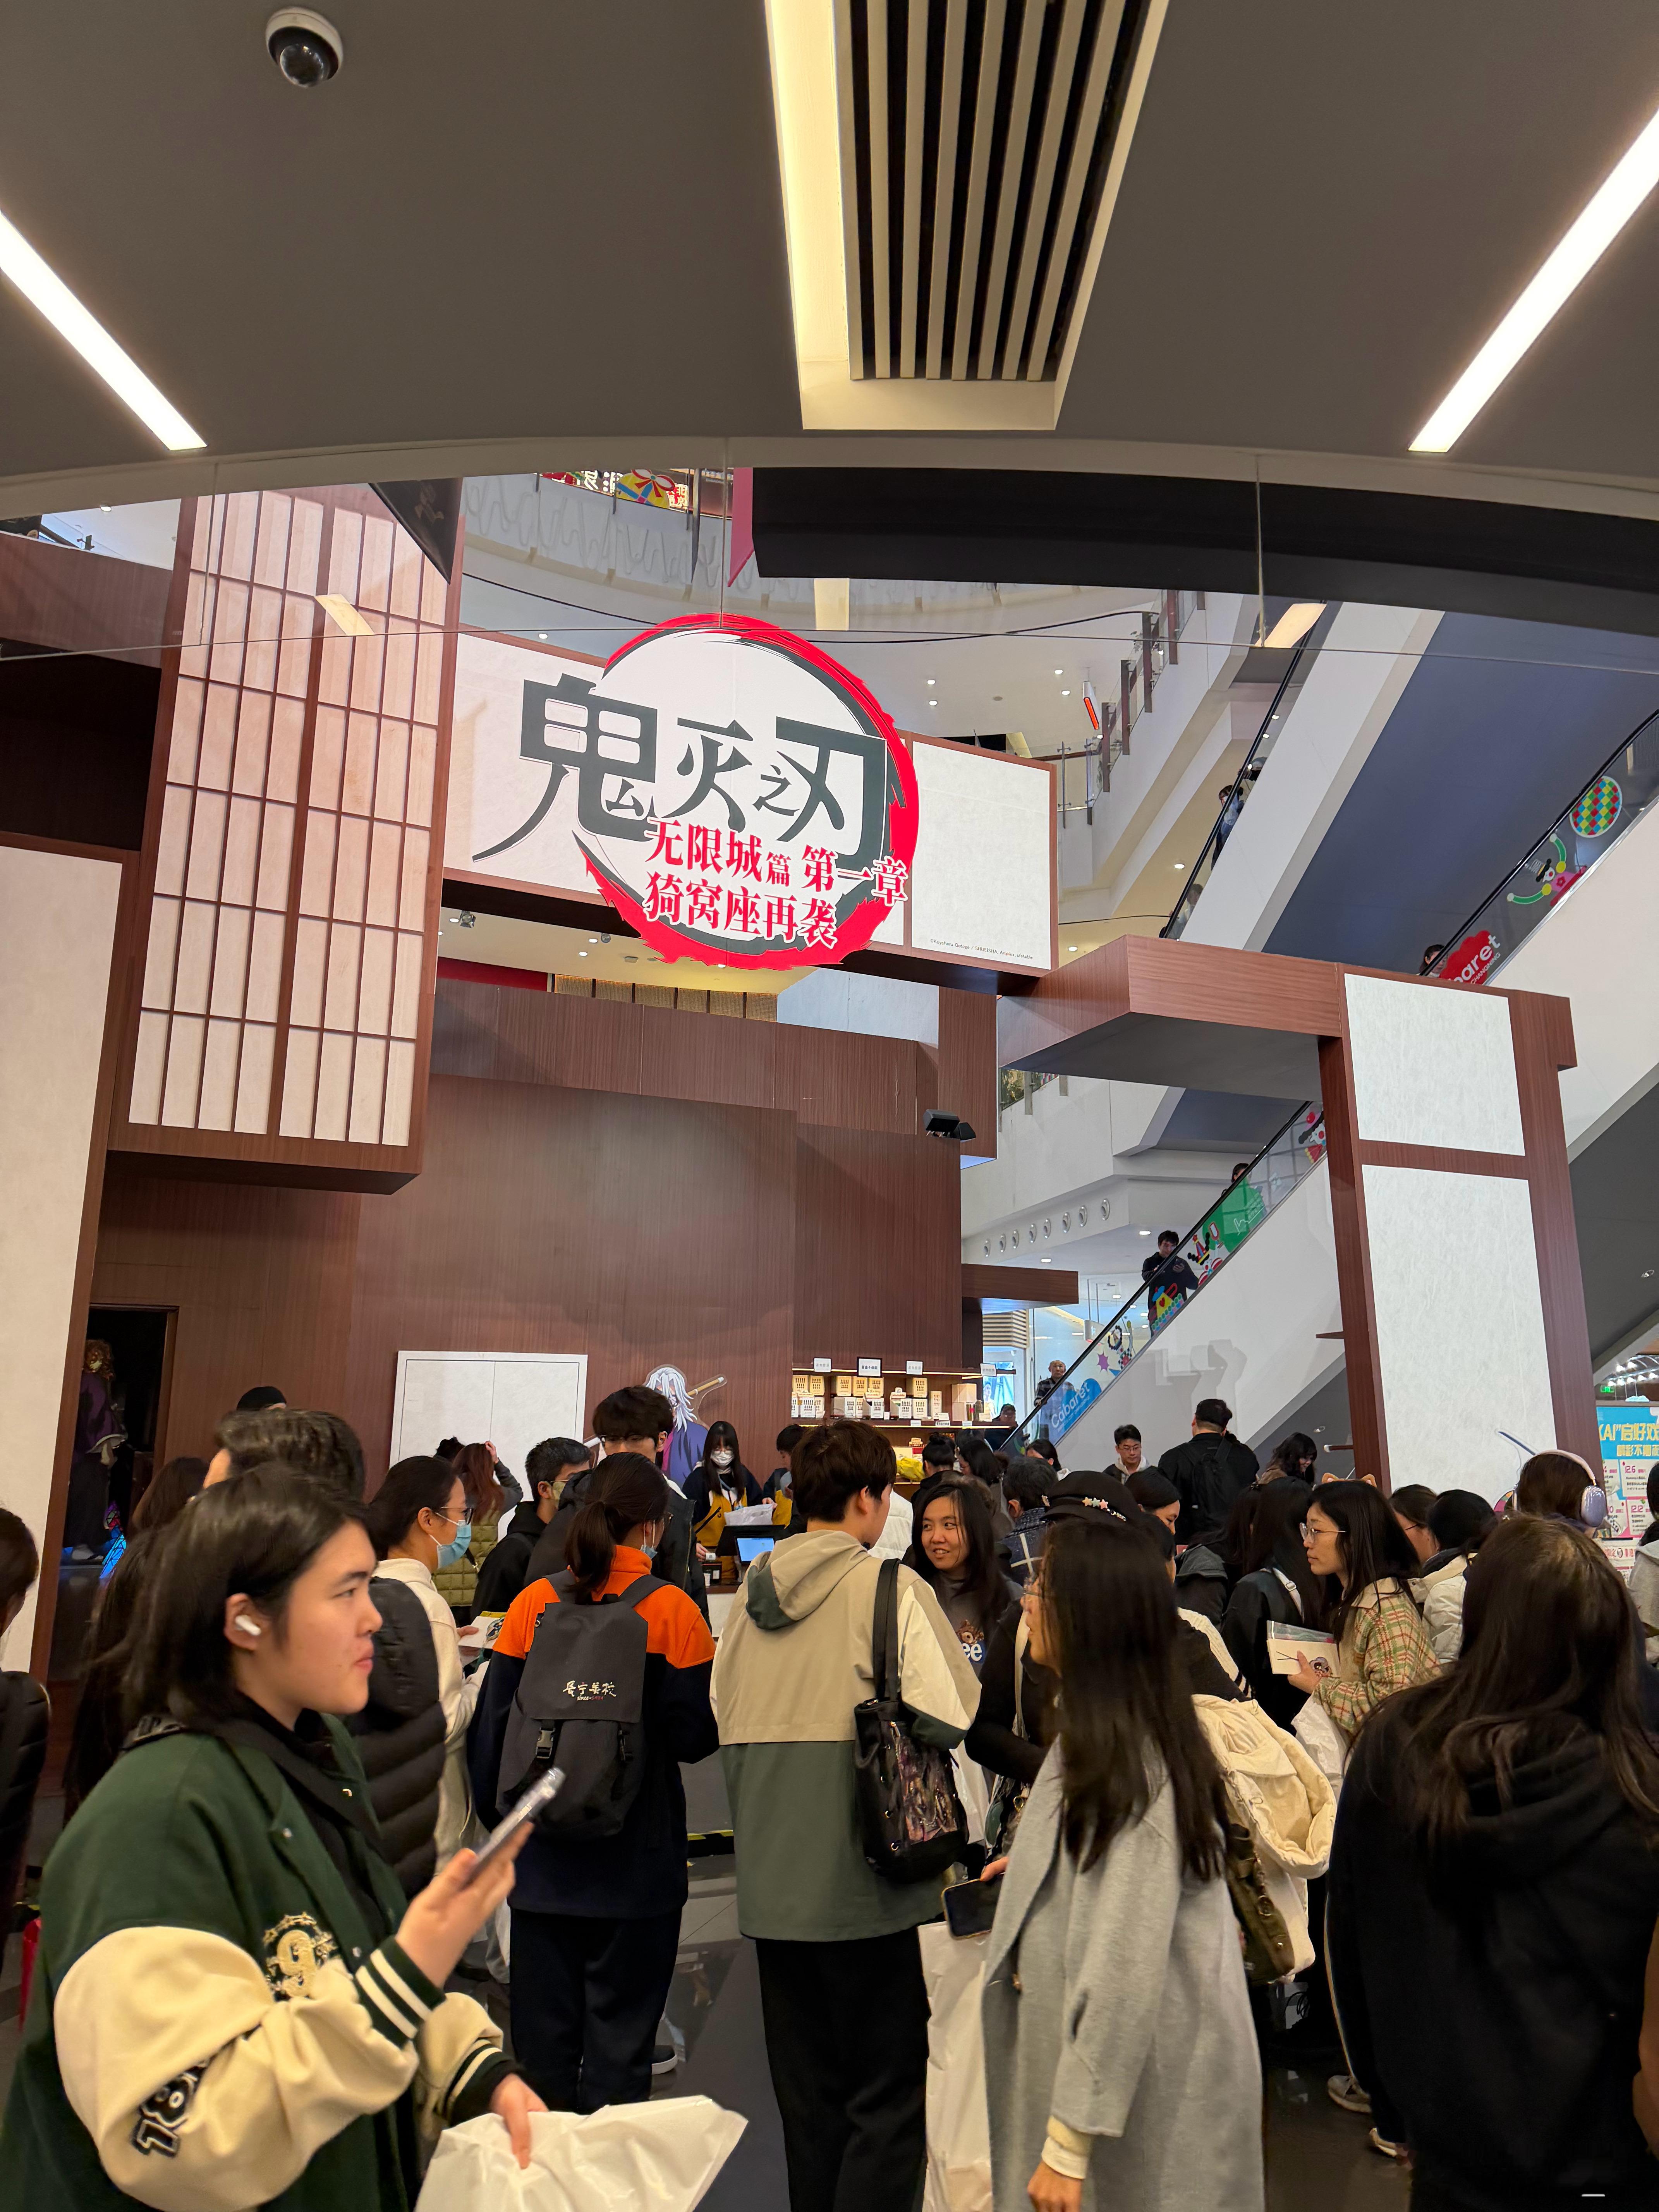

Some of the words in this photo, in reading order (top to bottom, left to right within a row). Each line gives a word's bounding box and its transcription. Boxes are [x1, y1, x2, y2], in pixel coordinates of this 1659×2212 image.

[473, 673, 887, 866] 鬼灭之刃
[644, 818, 792, 887] 无限城篇
[800, 843, 908, 905] 第一章
[643, 871, 838, 948] 猗窝座再袭
[1051, 1381, 1090, 1428] Cabaret
